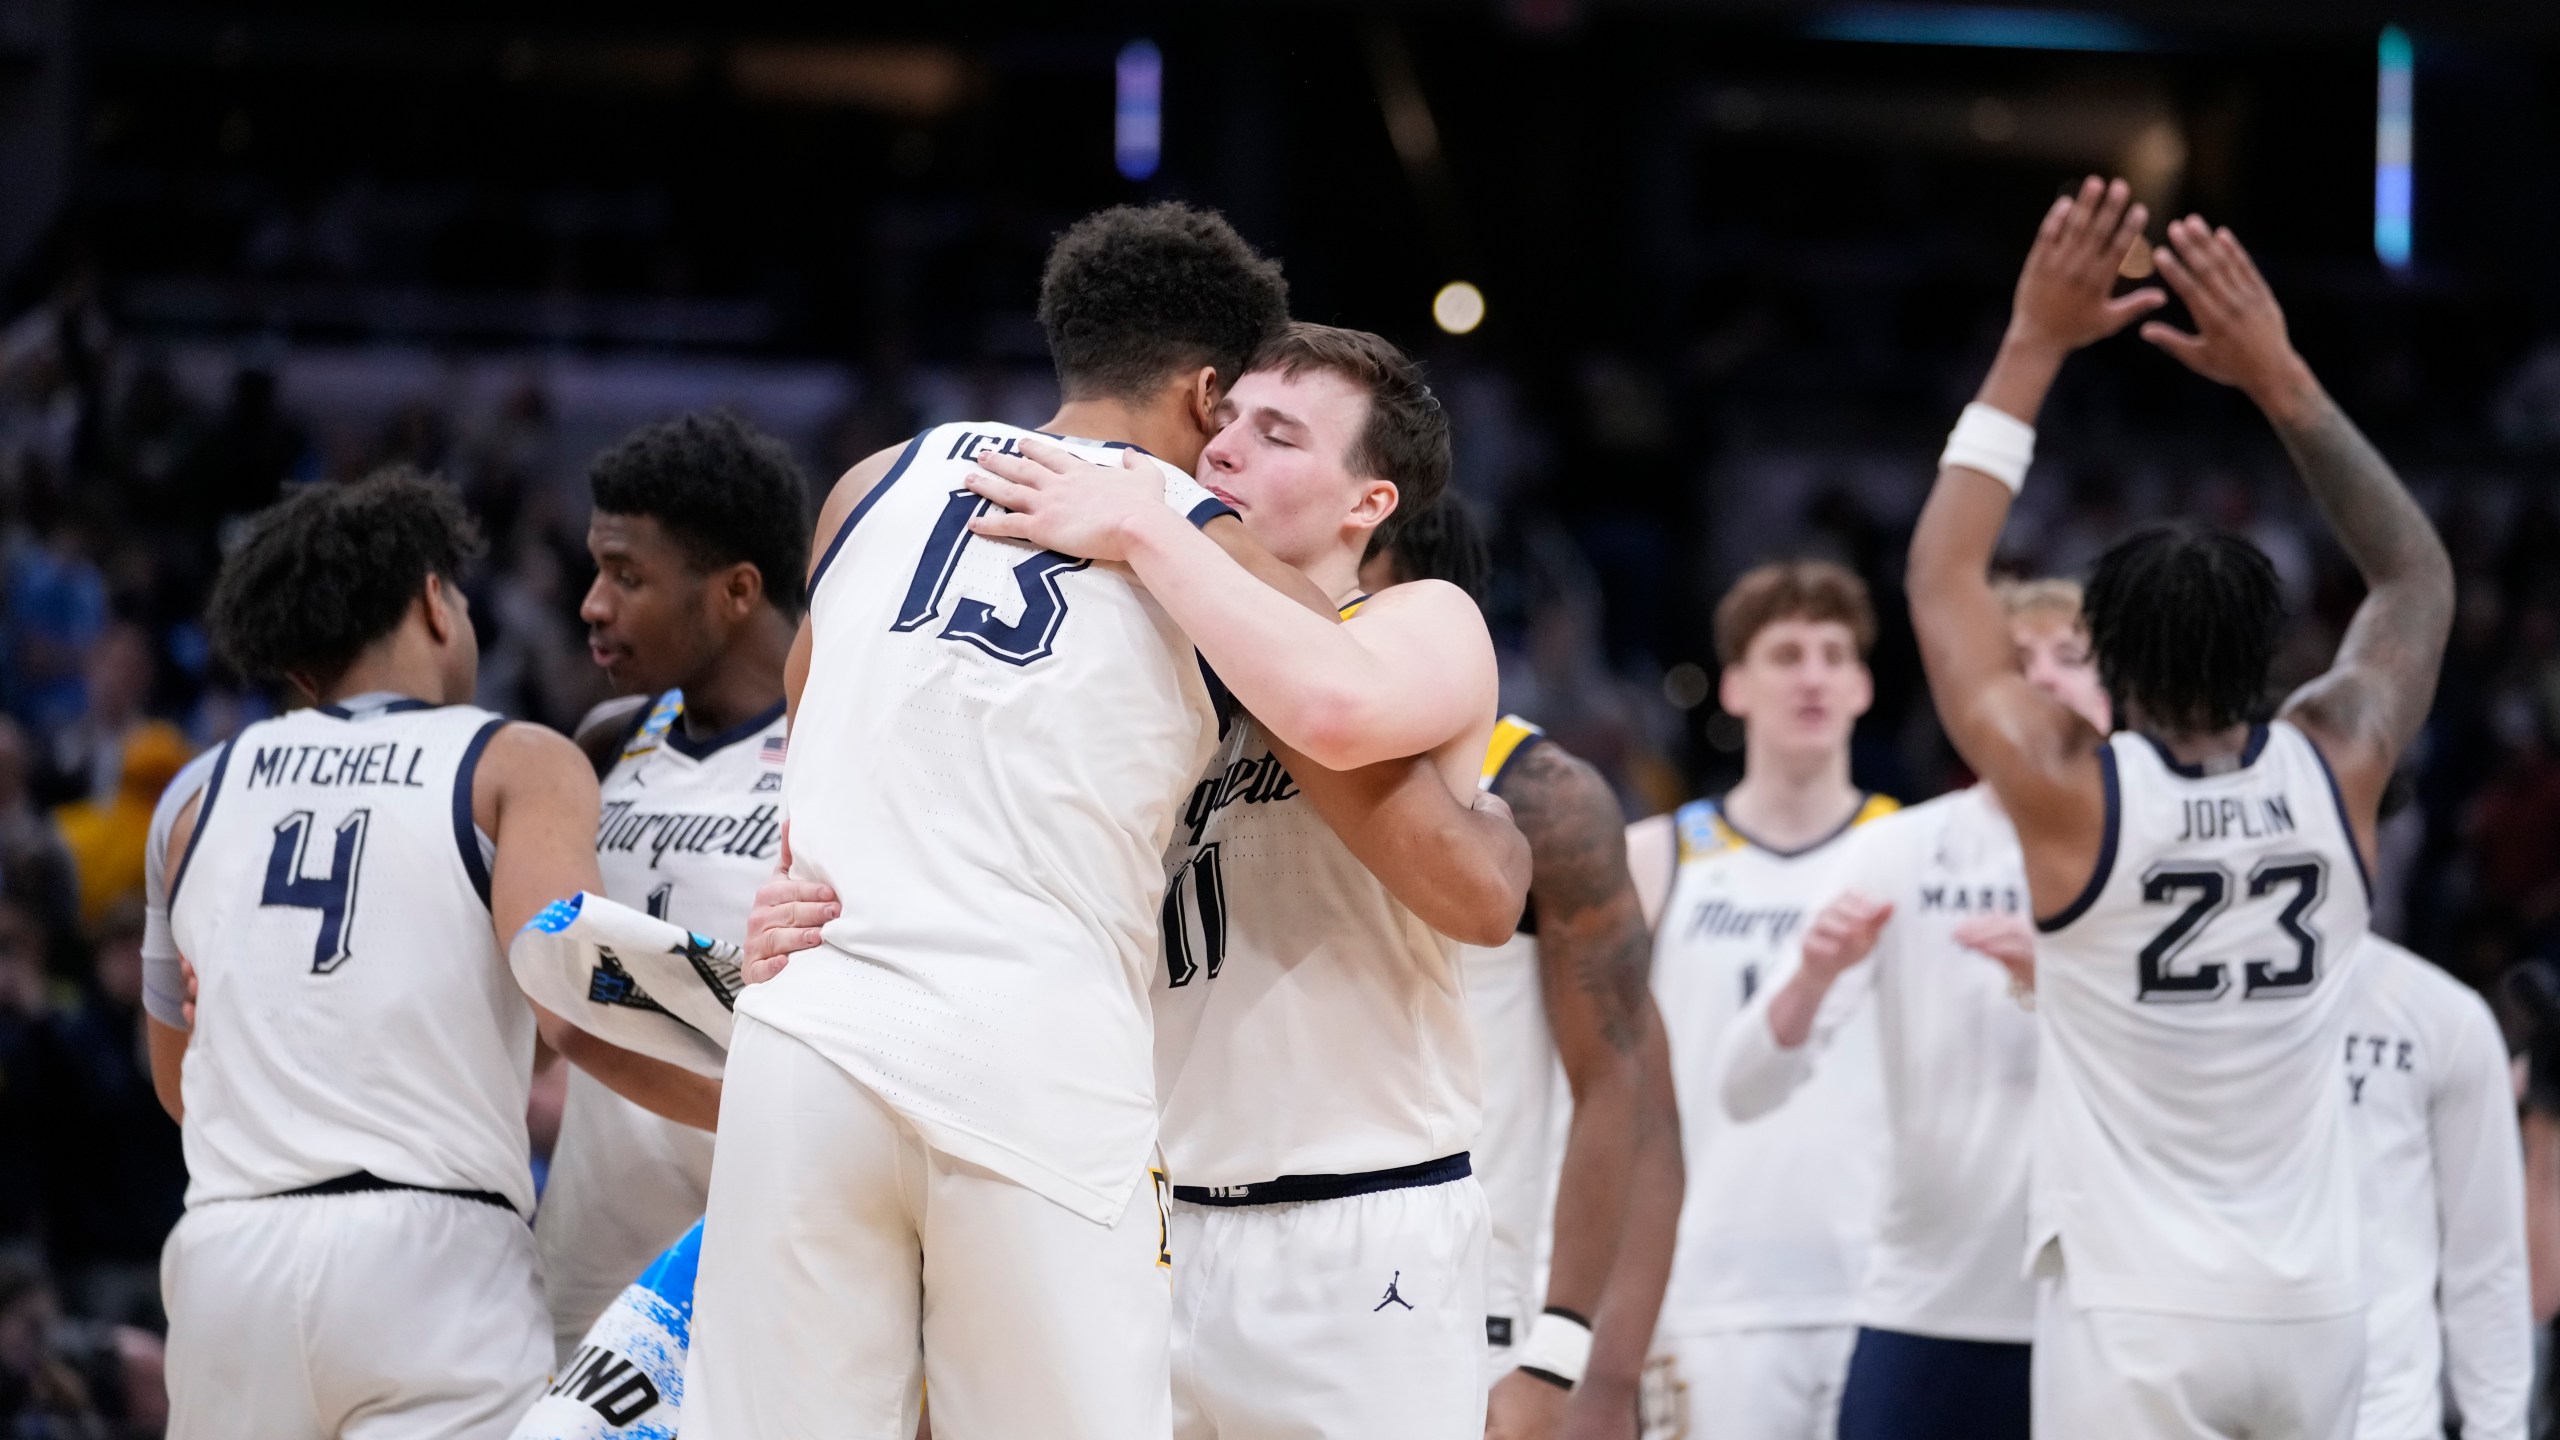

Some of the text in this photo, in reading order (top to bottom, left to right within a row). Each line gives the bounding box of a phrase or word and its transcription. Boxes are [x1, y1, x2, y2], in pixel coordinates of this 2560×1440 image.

[889, 488, 1094, 667] 13
[247, 741, 424, 790] MITCHELL
[2178, 795, 2296, 841] JOPLIN
[260, 807, 370, 975] 4
[1162, 841, 1227, 988] 11
[2137, 852, 2329, 1003] 23
